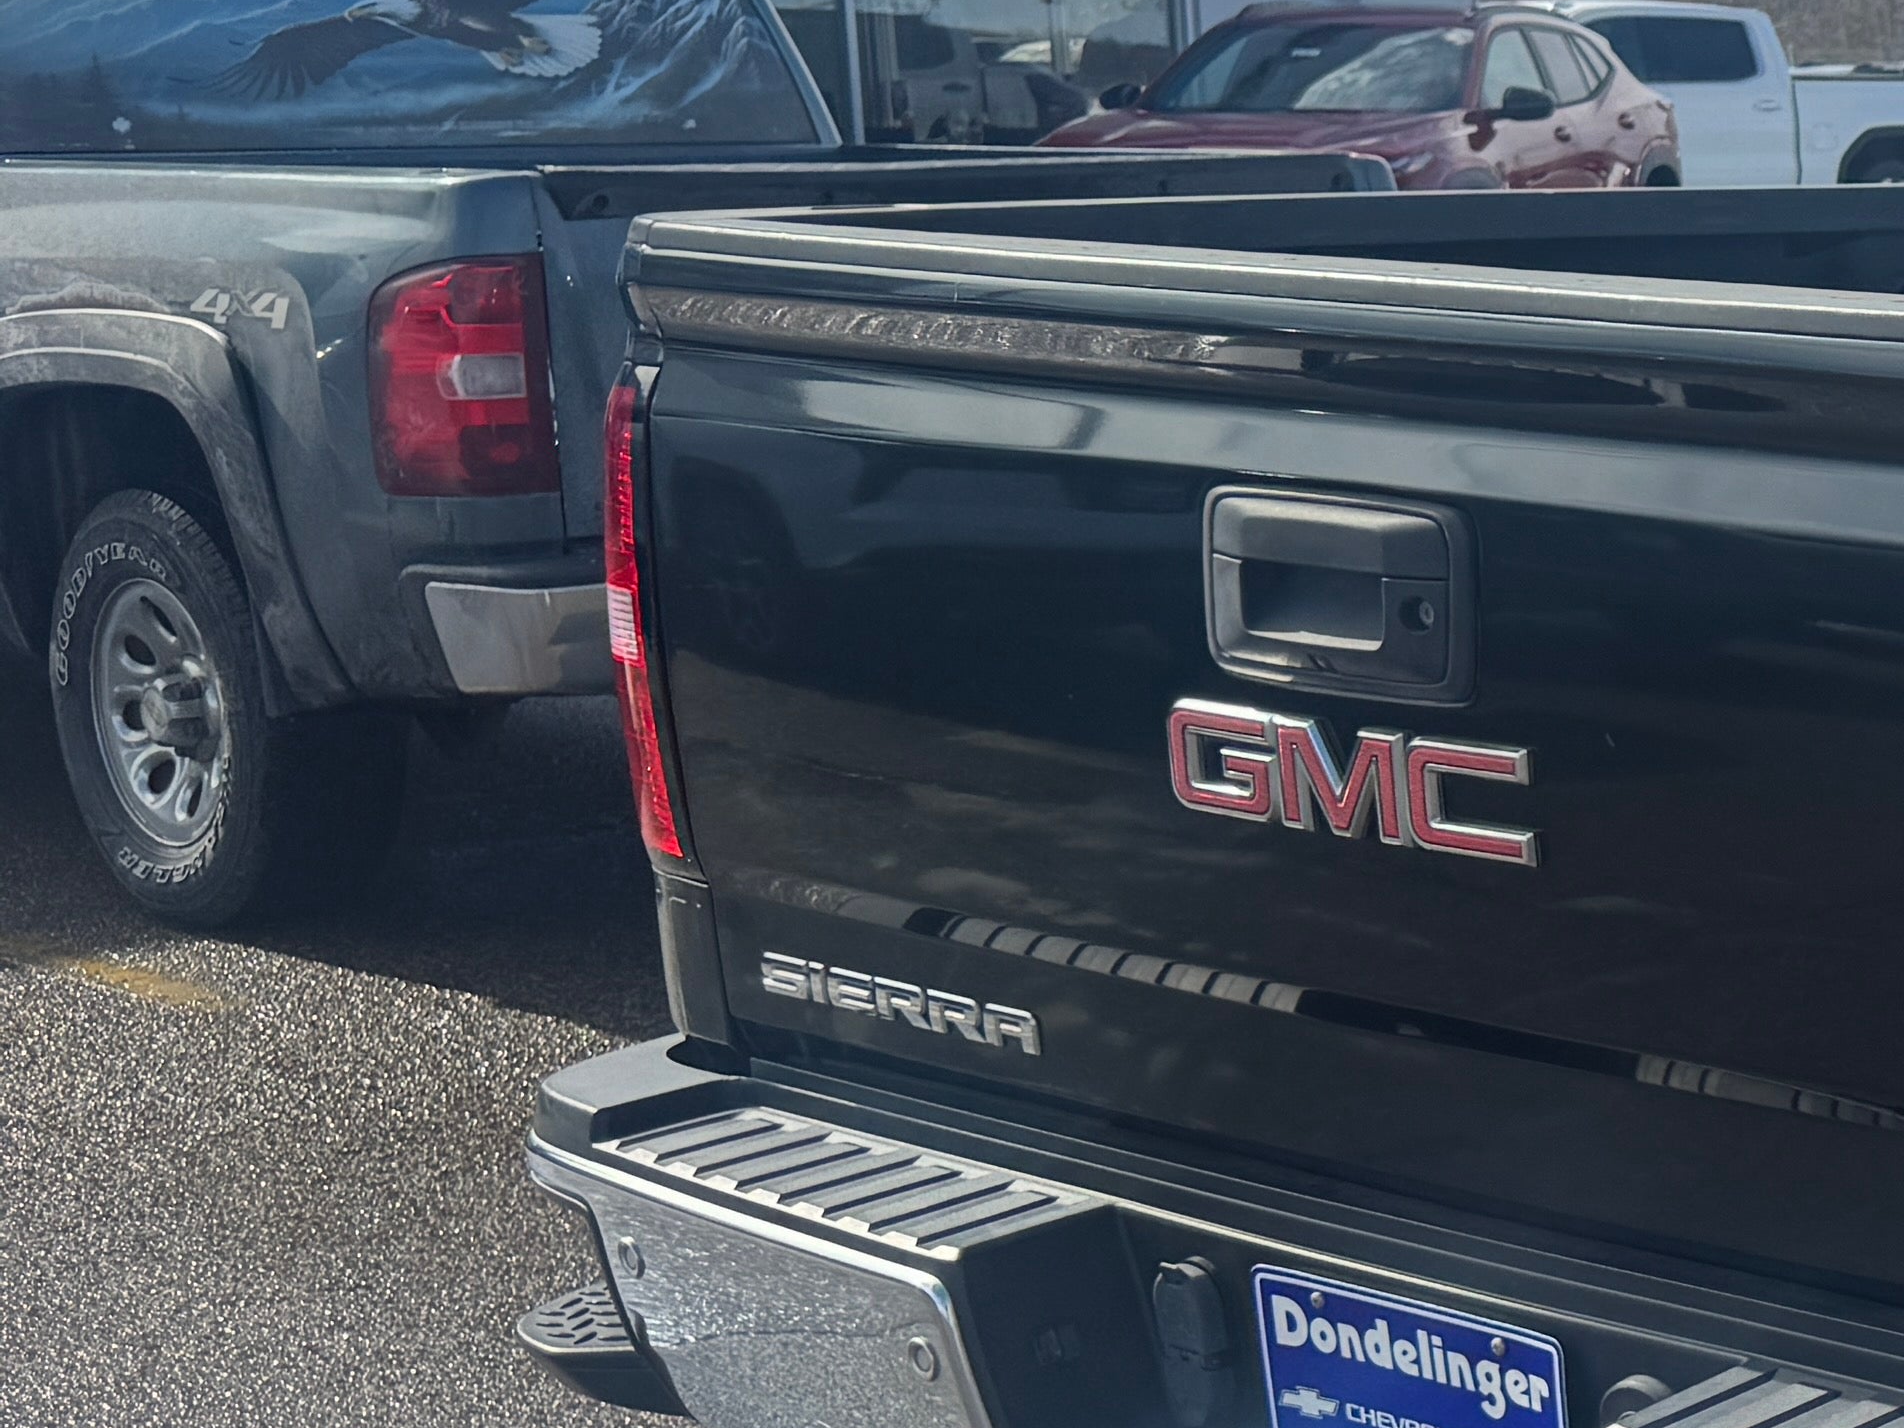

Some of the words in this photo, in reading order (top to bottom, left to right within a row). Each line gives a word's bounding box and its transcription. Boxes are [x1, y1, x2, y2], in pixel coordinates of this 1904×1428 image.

[1167, 697, 1541, 868] GMC
[761, 951, 1042, 1055] SIERRA
[1271, 1294, 1550, 1419] Dondelinger
